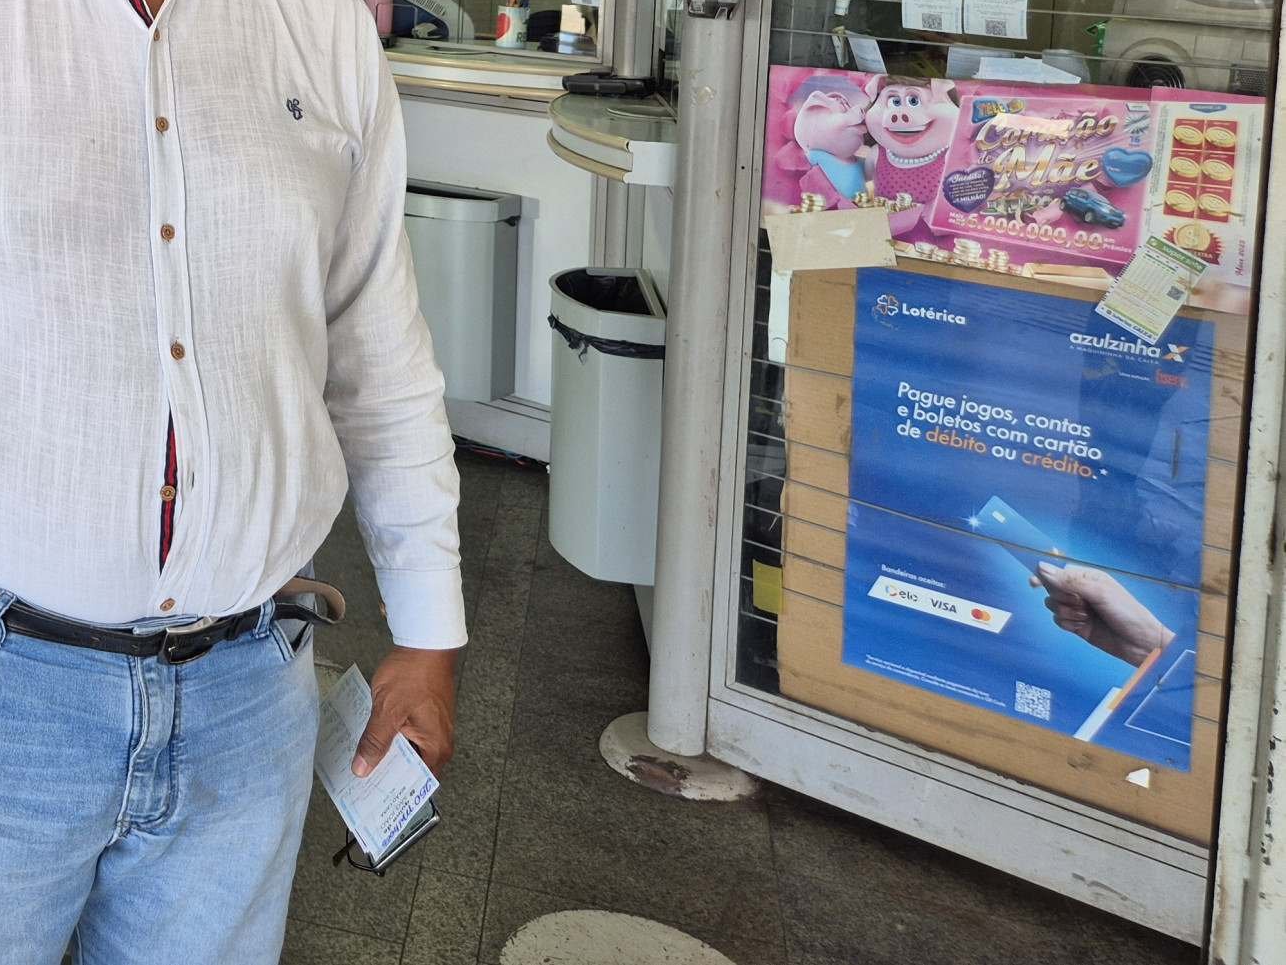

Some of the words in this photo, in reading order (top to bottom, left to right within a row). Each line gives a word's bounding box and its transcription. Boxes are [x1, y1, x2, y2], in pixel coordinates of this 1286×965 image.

[993, 143, 1101, 190] Mãe
[902, 303, 966, 325] Lotérica
[1069, 333, 1161, 358] azulzinha
[897, 382, 956, 408] Pague
[960, 395, 1018, 425] jogos,
[1025, 414, 1091, 437] contas
[897, 405, 909, 417] e
[913, 403, 981, 433] boletos
[986, 425, 1028, 444] com
[1033, 436, 1102, 461] cartão
[897, 419, 921, 438] de
[925, 426, 987, 454] débito
[991, 445, 1015, 460] ou
[899, 590, 918, 602] elo
[931, 598, 958, 613] VISA
